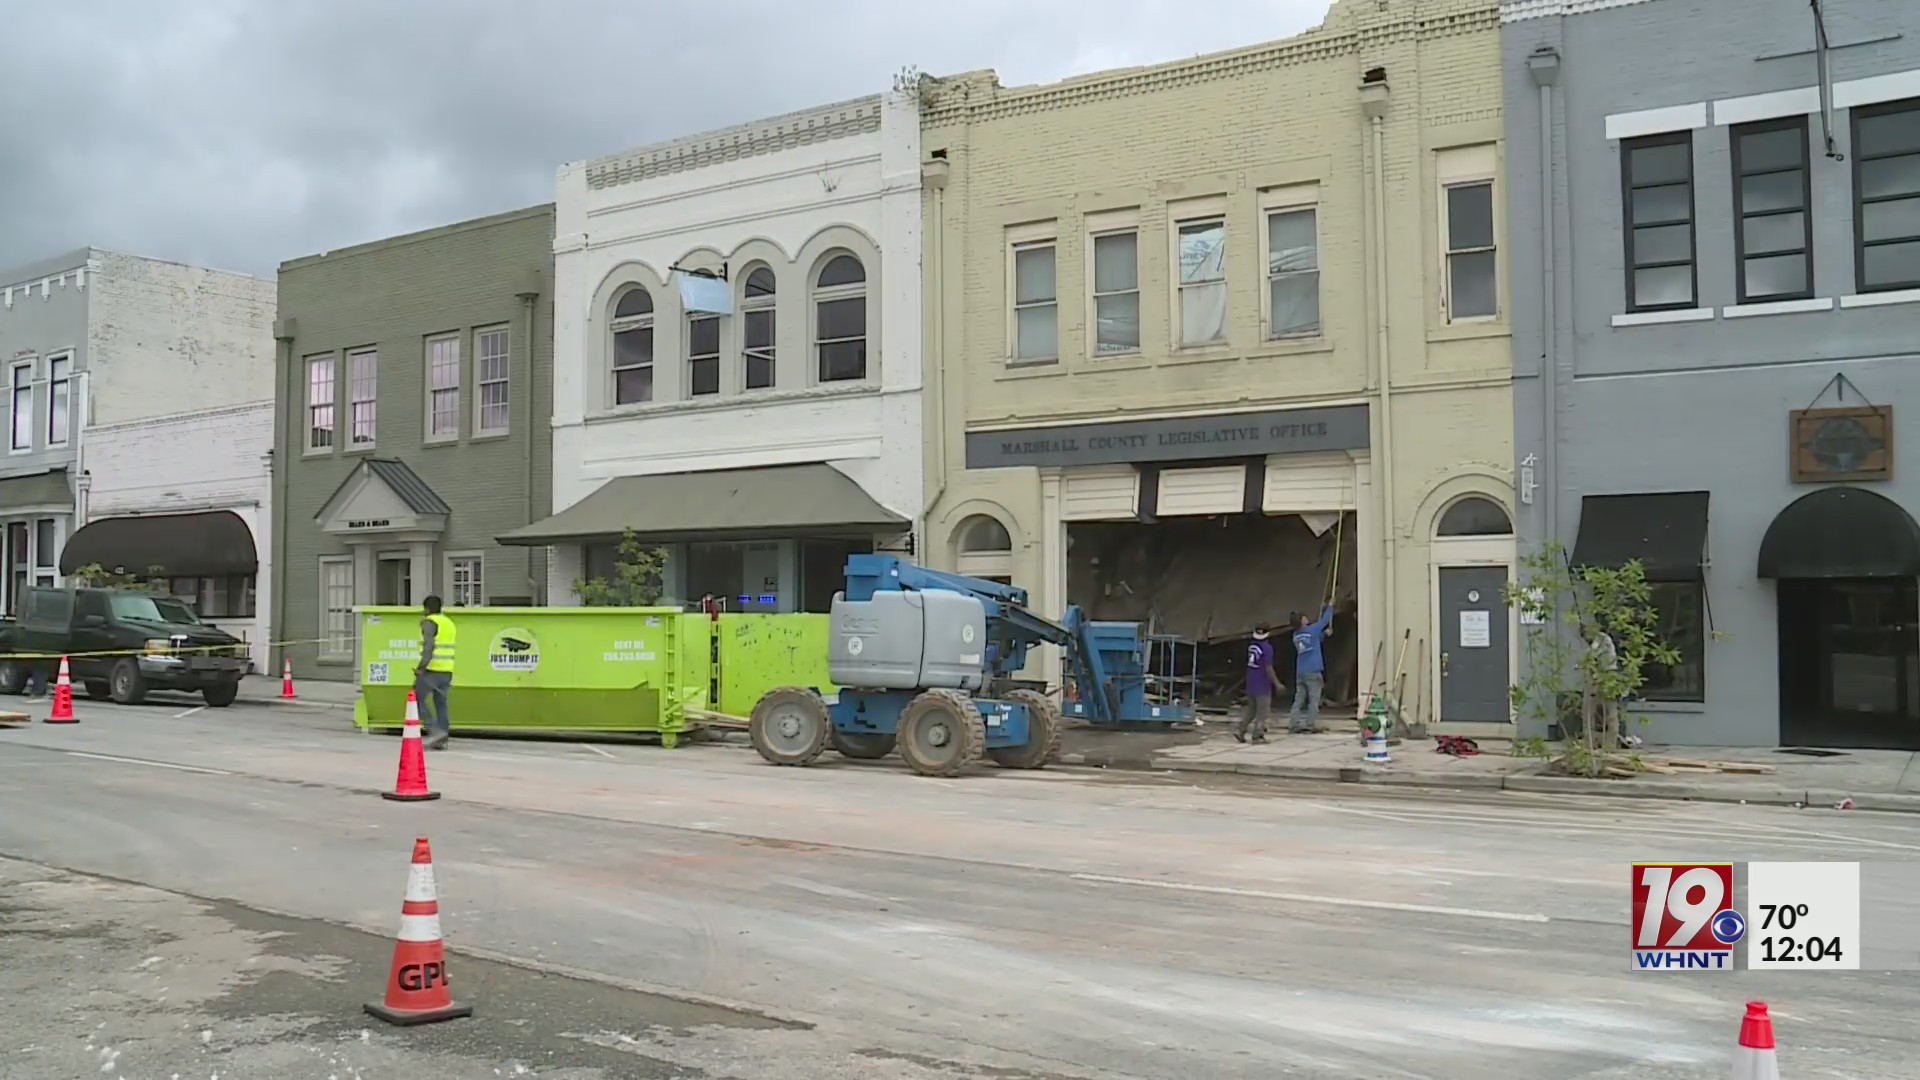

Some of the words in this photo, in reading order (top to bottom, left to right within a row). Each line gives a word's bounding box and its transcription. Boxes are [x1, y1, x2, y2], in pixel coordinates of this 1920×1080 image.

[1001, 439, 1080, 454] MARSHALL
[1088, 434, 1148, 450] COUNTY
[1158, 427, 1260, 446] LEGISLATIVE
[1270, 422, 1328, 438] OFFICE
[490, 653, 507, 663] JUST
[509, 654, 530, 663] DUMP
[531, 654, 538, 663] IT
